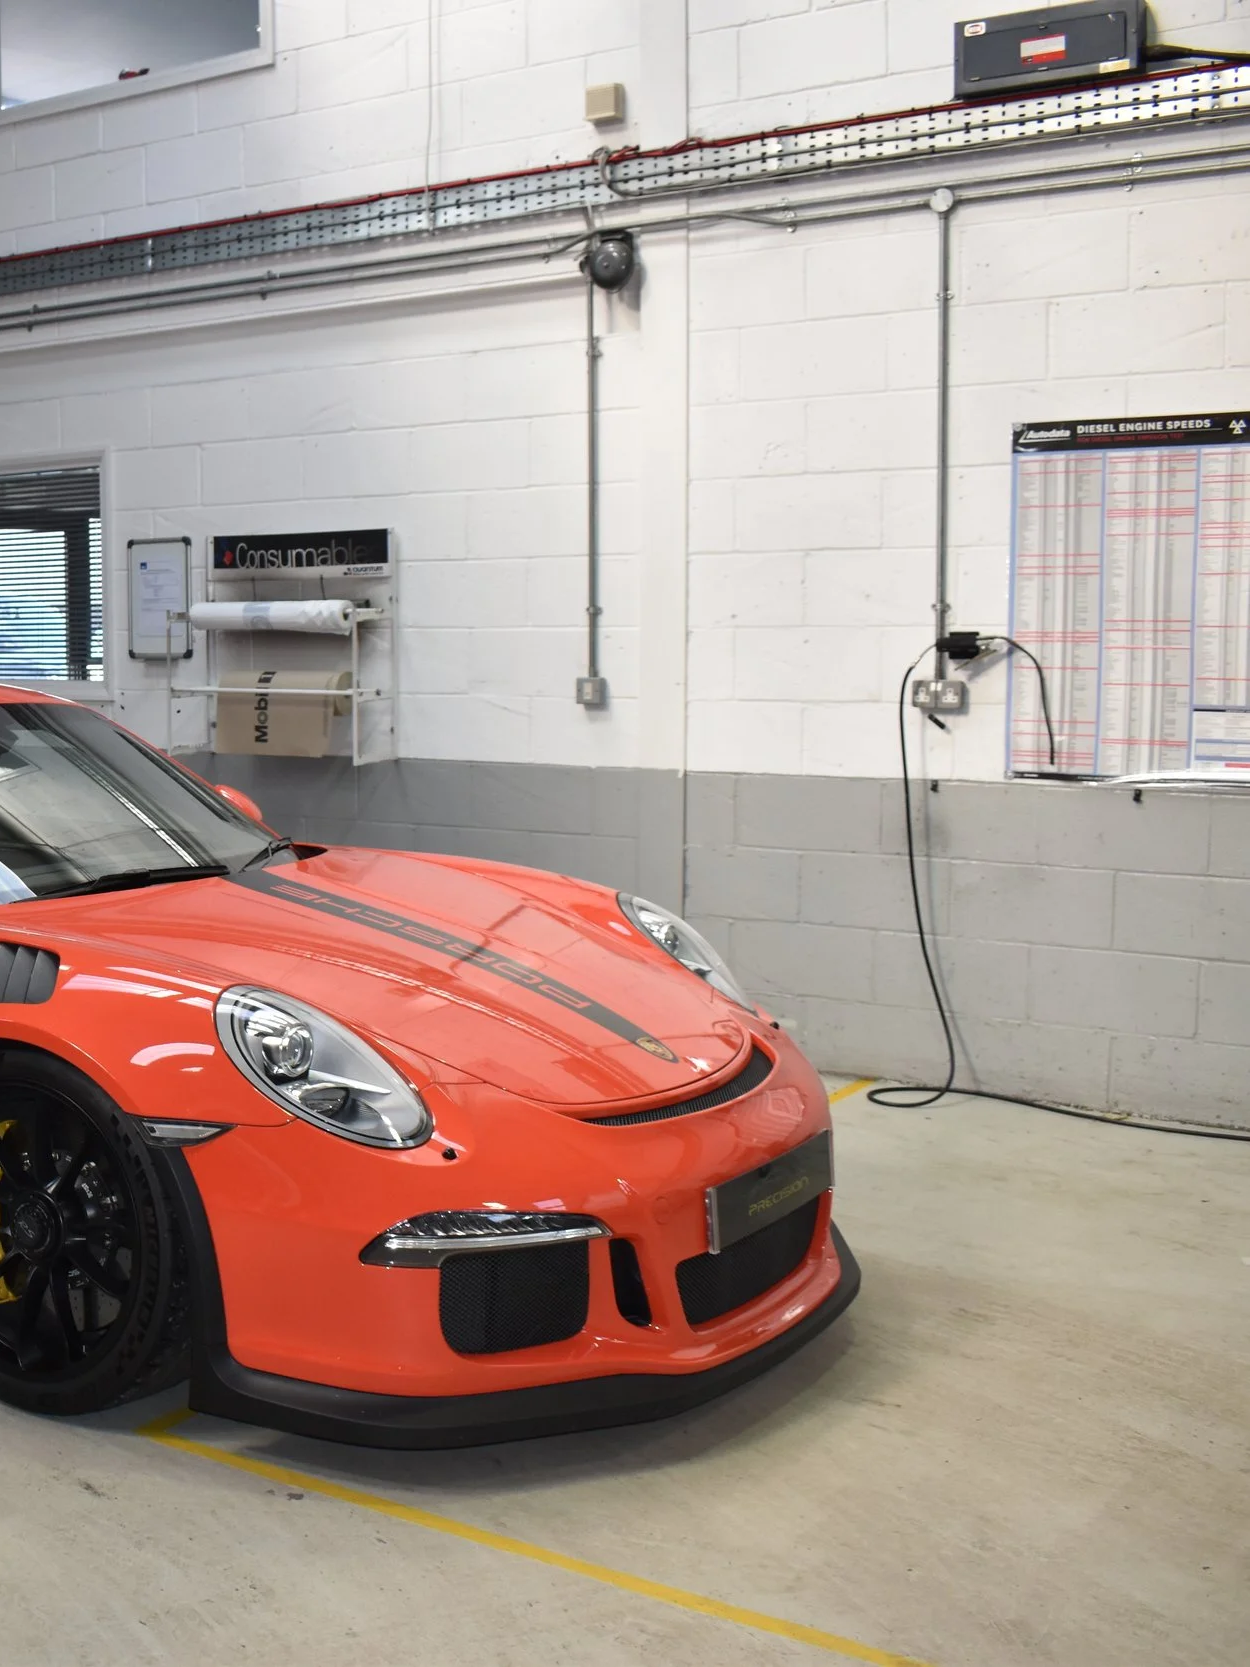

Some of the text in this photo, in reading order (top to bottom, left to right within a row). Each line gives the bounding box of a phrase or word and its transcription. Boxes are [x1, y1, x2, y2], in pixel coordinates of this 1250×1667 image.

[1076, 419, 1211, 434] DIESEL ENGINE SPEEDS
[254, 686, 269, 743] Mobil
[269, 883, 593, 1009] PORSCHE
